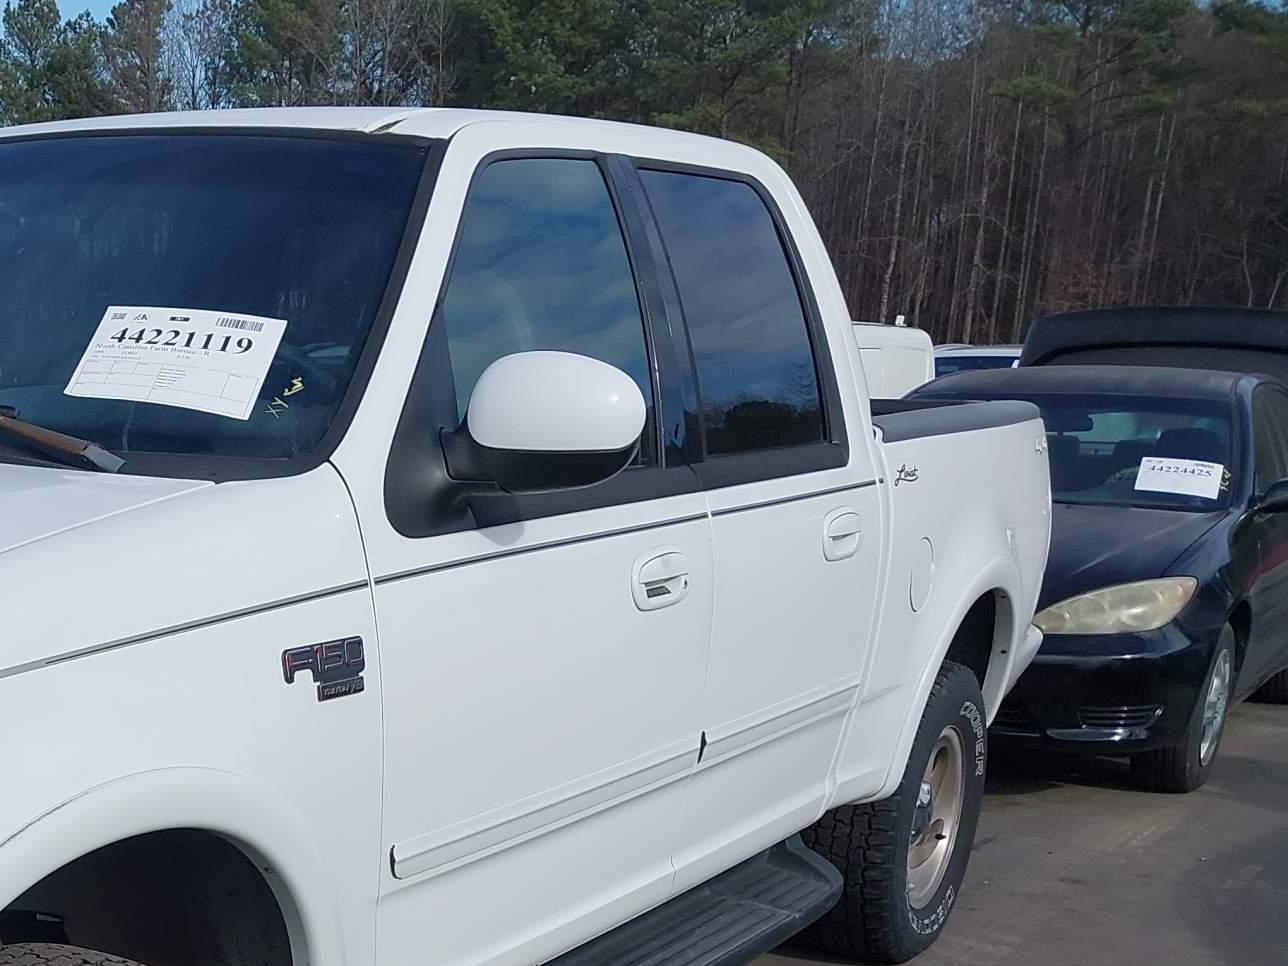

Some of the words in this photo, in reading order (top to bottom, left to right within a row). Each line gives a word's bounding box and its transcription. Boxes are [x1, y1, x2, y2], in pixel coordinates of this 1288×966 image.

[110, 327, 254, 354] 44221119
[118, 343, 148, 351] Carolina
[1149, 464, 1213, 478] 44224425
[959, 701, 985, 776] COOPER
